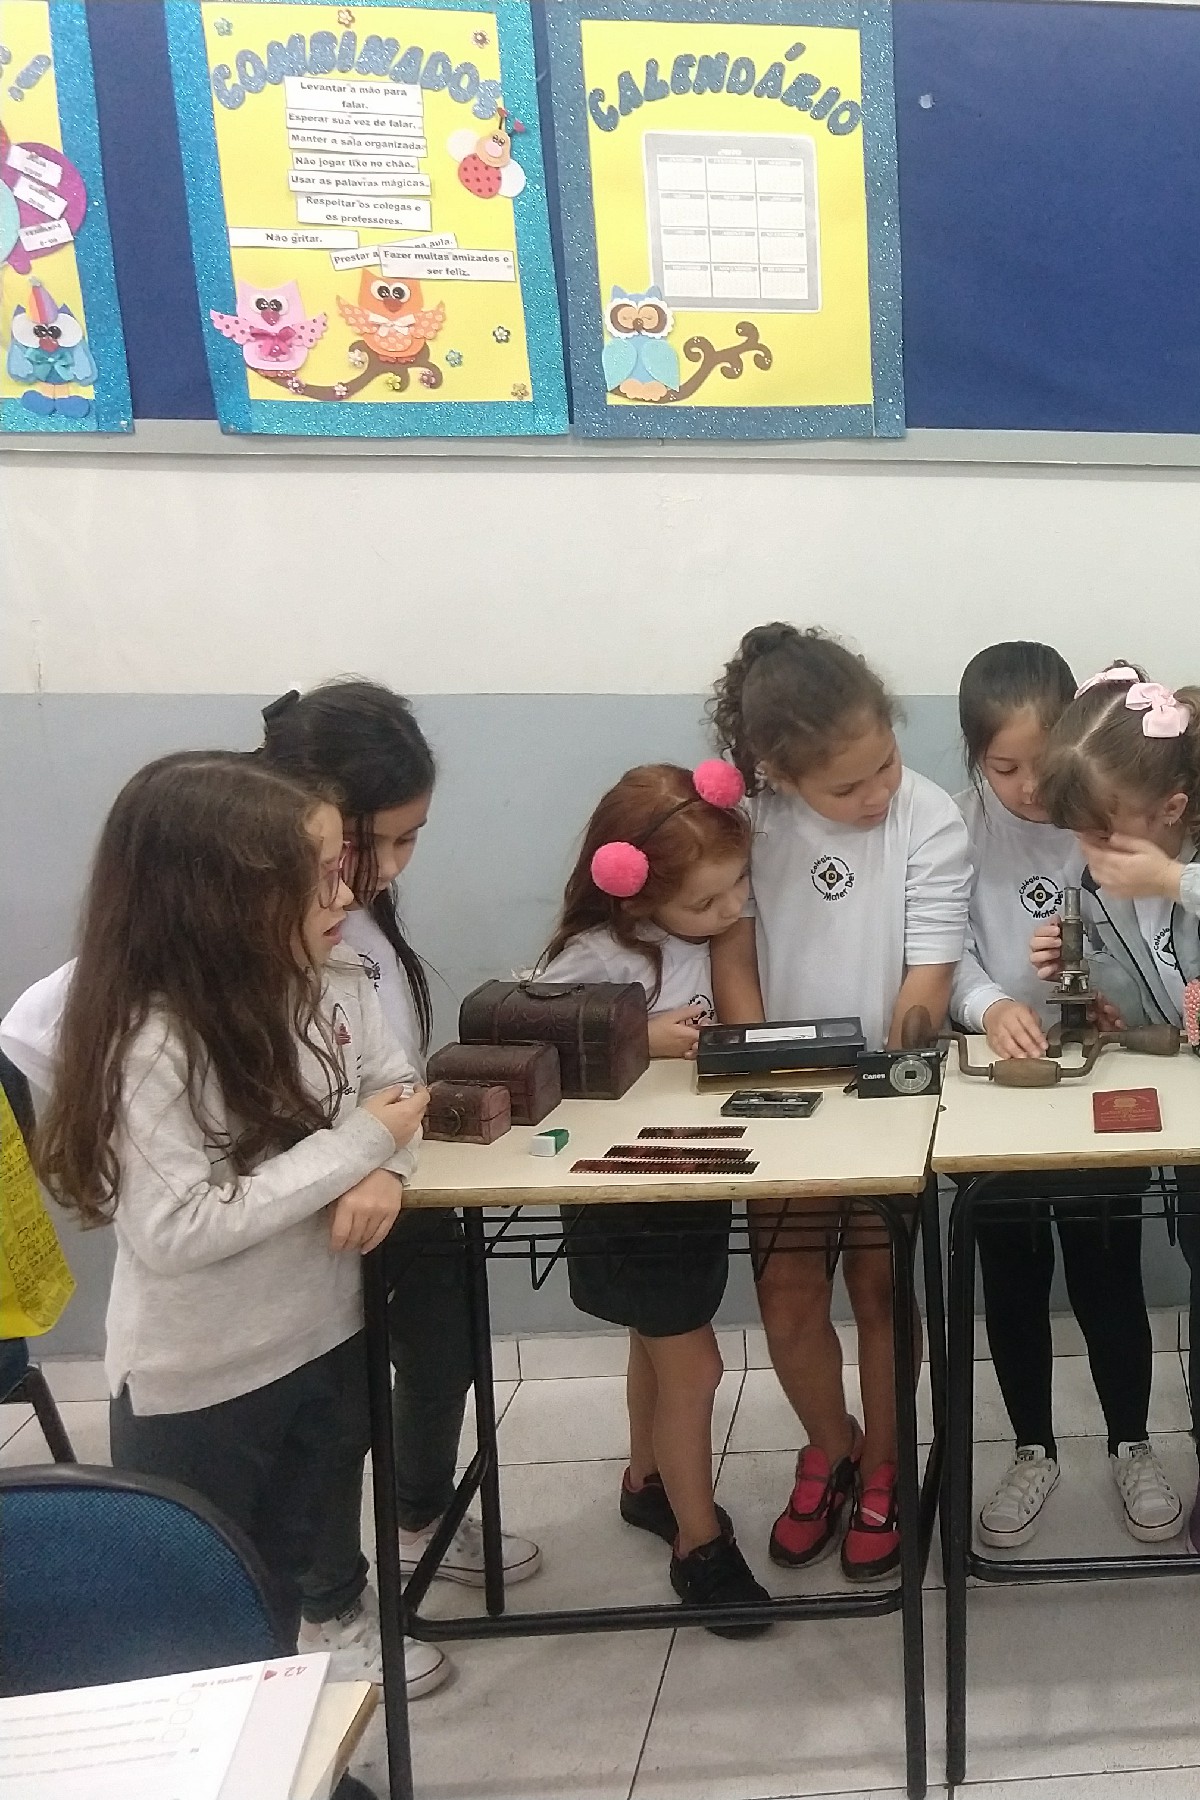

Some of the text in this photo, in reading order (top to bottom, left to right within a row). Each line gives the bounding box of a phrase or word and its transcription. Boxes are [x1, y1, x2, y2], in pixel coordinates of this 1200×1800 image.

[213, 30, 502, 120] COMBINADOS
[300, 82, 346, 93] Levantar
[359, 85, 381, 94] mão
[384, 88, 408, 97] para
[588, 42, 862, 136] CALENDÁRIO
[341, 100, 369, 109] falar.
[288, 113, 417, 129] Esperar sua vez de falar.
[291, 134, 327, 144] Manter
[341, 137, 362, 147] sala
[295, 157, 316, 165] Não
[318, 157, 345, 167] jogar
[348, 159, 368, 167] lixo
[291, 175, 316, 184] Usar
[335, 178, 379, 187] palavras
[381, 178, 430, 188] mágicas.
[305, 195, 356, 208] Respeitar
[359, 201, 371, 209] os
[373, 201, 412, 212] colegas
[325, 213, 403, 225] os professores.
[265, 233, 323, 244] Não gritar.
[334, 252, 370, 264] Prestar
[429, 238, 453, 247] aula.
[384, 250, 412, 260] Fazer
[414, 252, 449, 261] muitas
[452, 254, 500, 263] amizades
[426, 267, 471, 277] ser feliz.
[823, 872, 855, 902] Mater Dei
